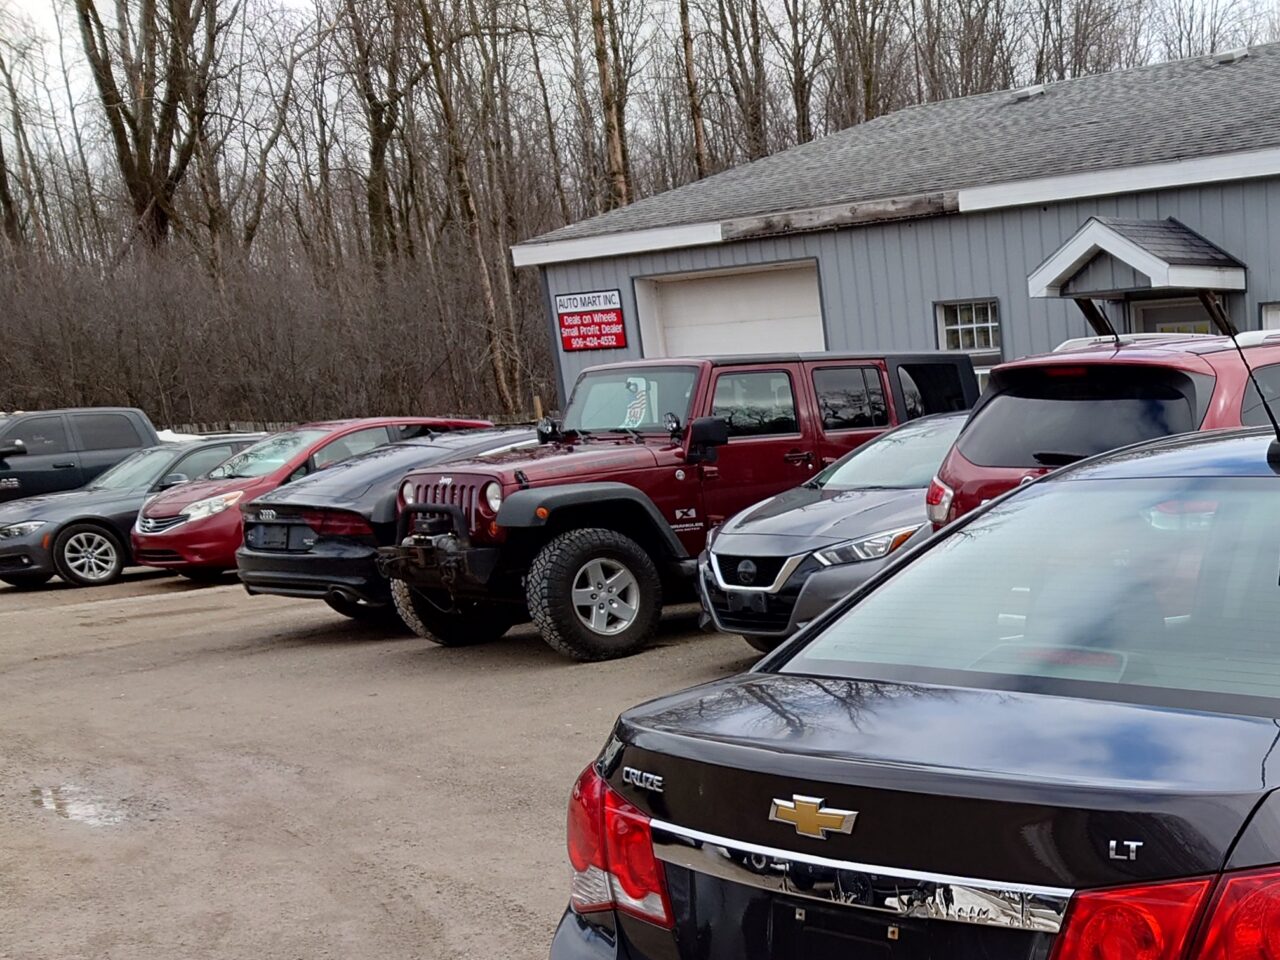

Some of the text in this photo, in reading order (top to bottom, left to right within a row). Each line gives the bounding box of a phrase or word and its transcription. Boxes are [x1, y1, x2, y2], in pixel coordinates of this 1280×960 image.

[558, 293, 618, 308] AUTO MART INC.
[563, 312, 617, 325] Deals on Wheels
[561, 323, 623, 337] Small Profit Dealer
[623, 766, 664, 793] CRUZE
[1109, 840, 1144, 861] LT
